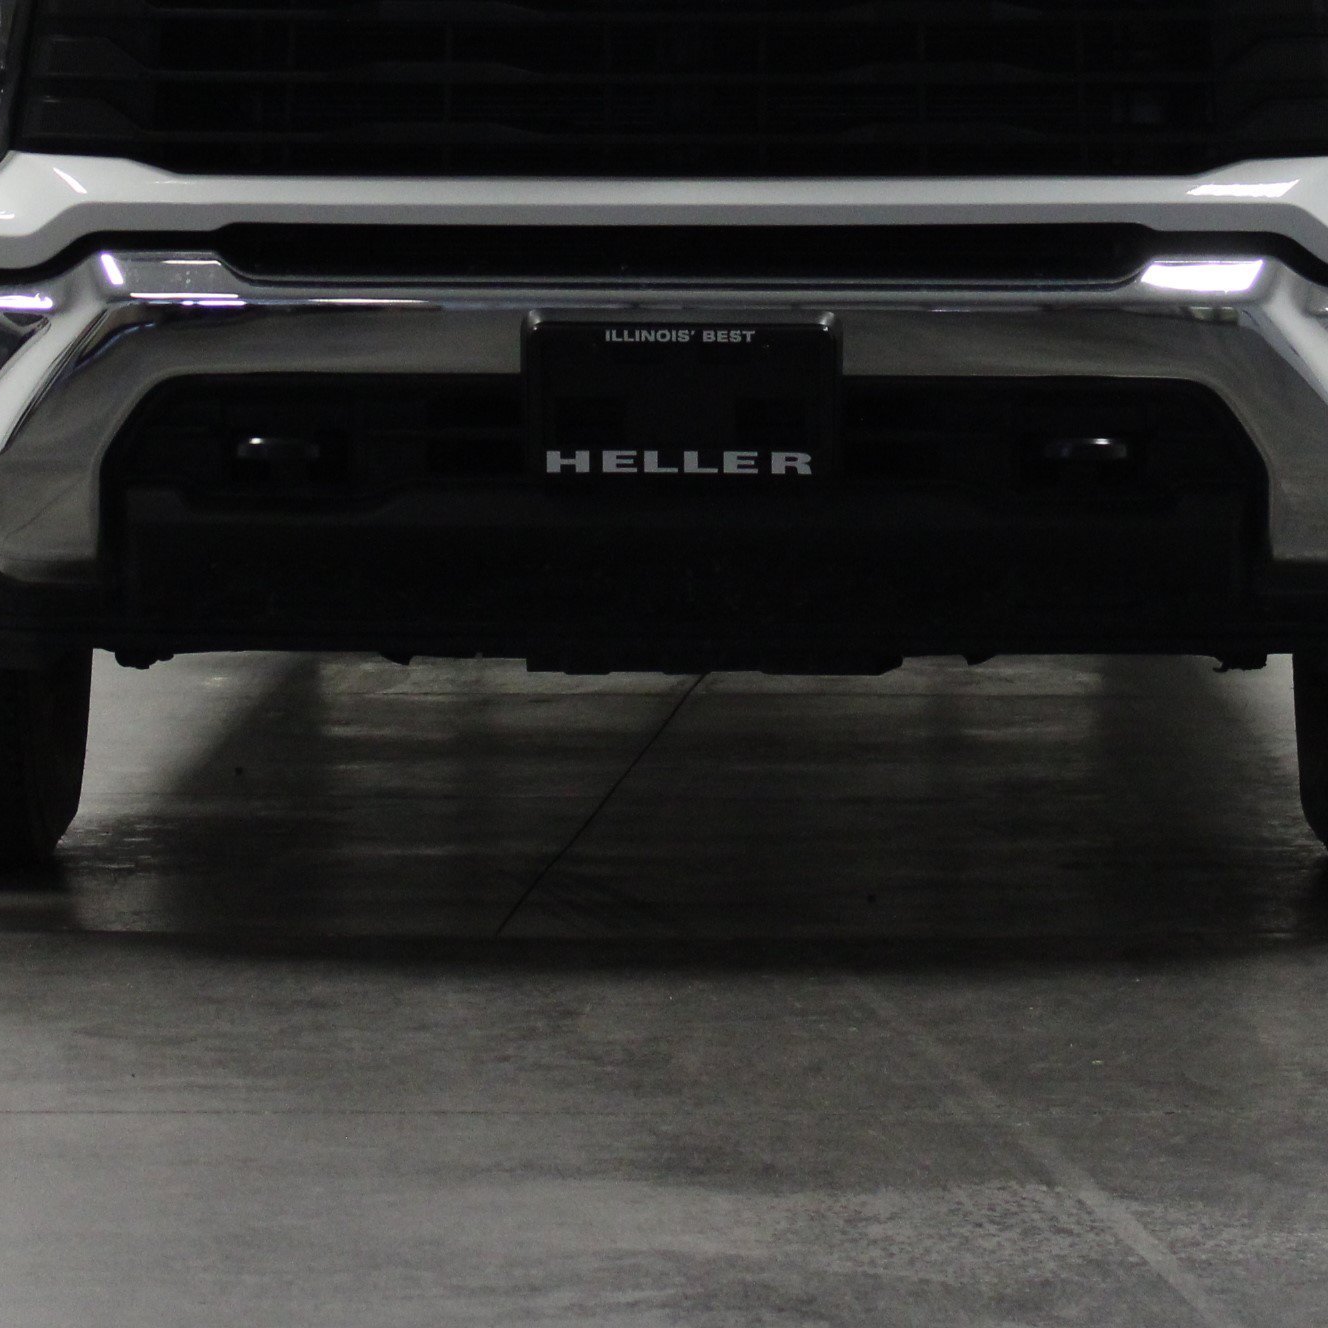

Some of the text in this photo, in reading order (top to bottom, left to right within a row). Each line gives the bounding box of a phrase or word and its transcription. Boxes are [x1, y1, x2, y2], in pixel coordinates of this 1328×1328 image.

[605, 329, 756, 343] ILLINOIS' BEST
[546, 450, 812, 475] HELLER
